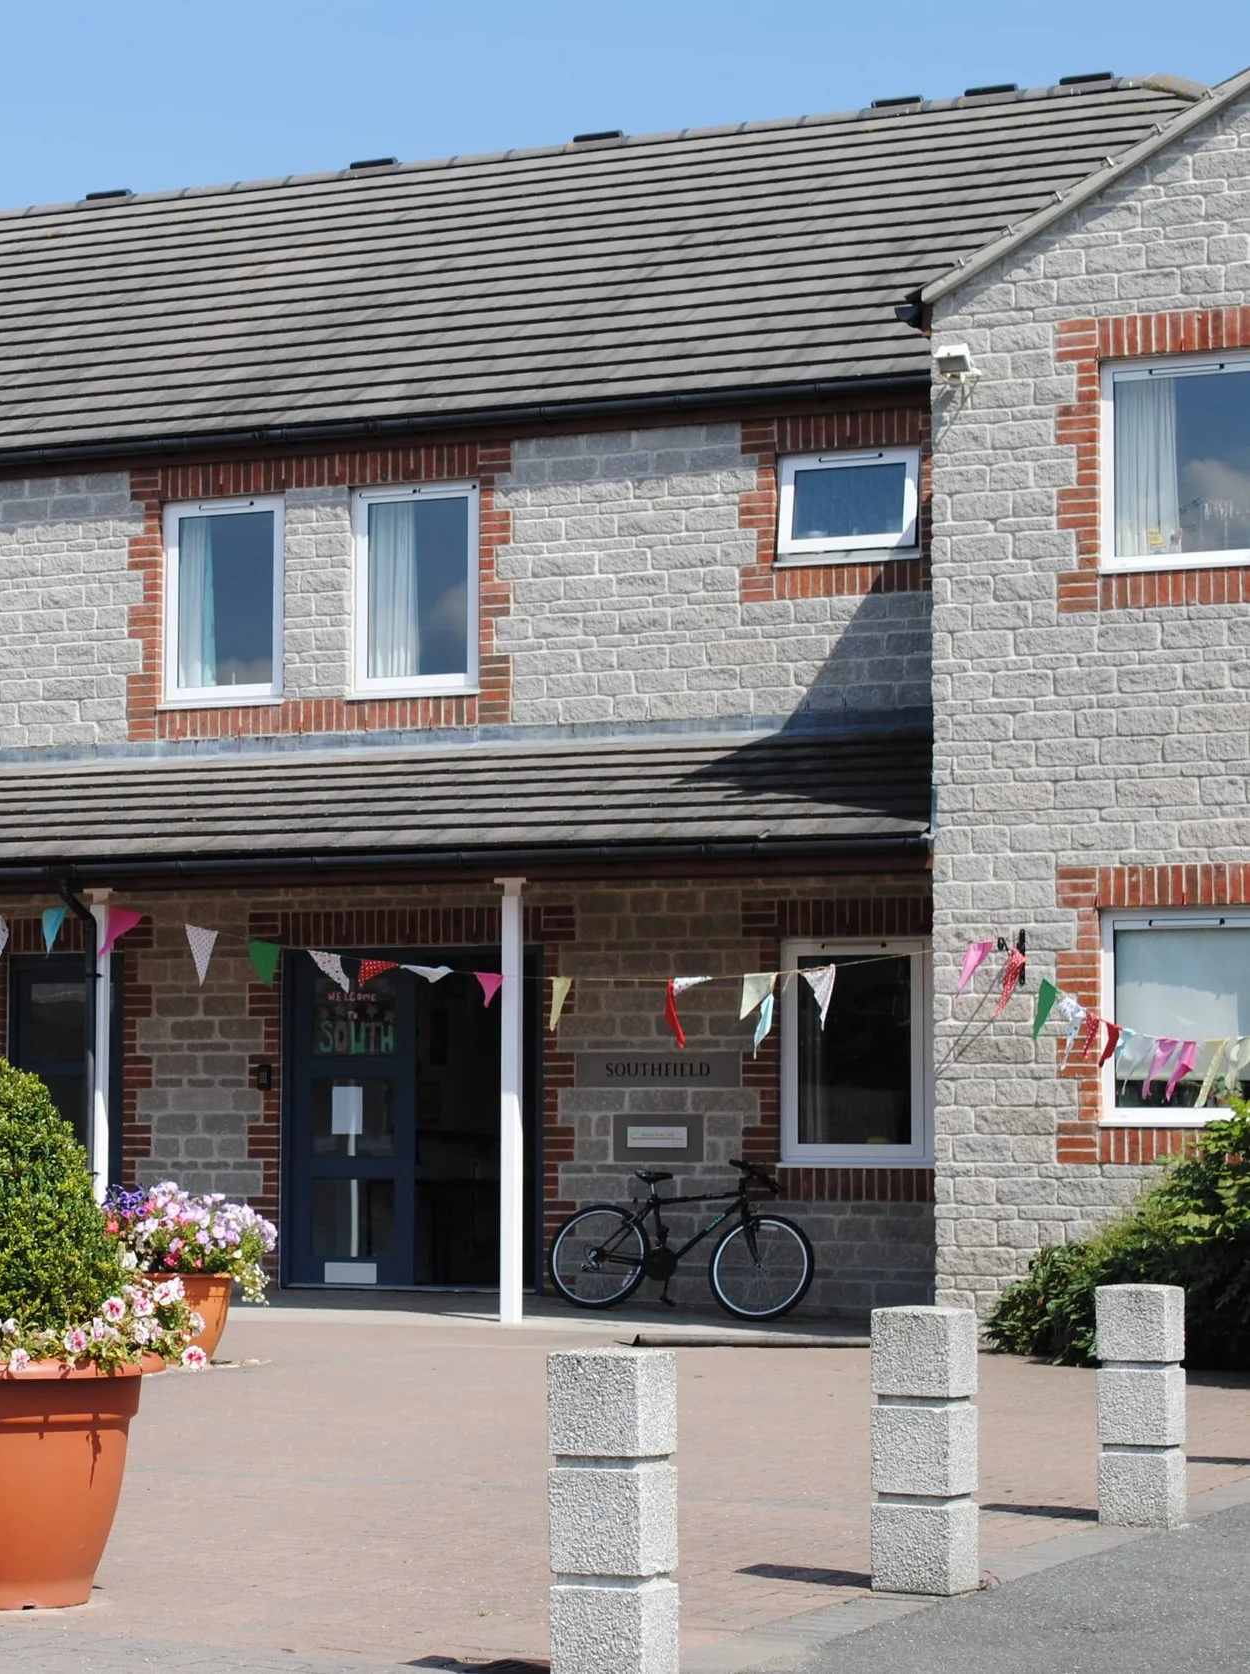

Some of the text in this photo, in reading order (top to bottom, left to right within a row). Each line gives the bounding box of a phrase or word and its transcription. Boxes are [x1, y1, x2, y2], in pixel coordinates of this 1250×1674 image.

[327, 992, 377, 1002] WELCOME
[320, 1020, 394, 1054] SOUTH
[605, 1062, 711, 1078] SOUTHFIELD
